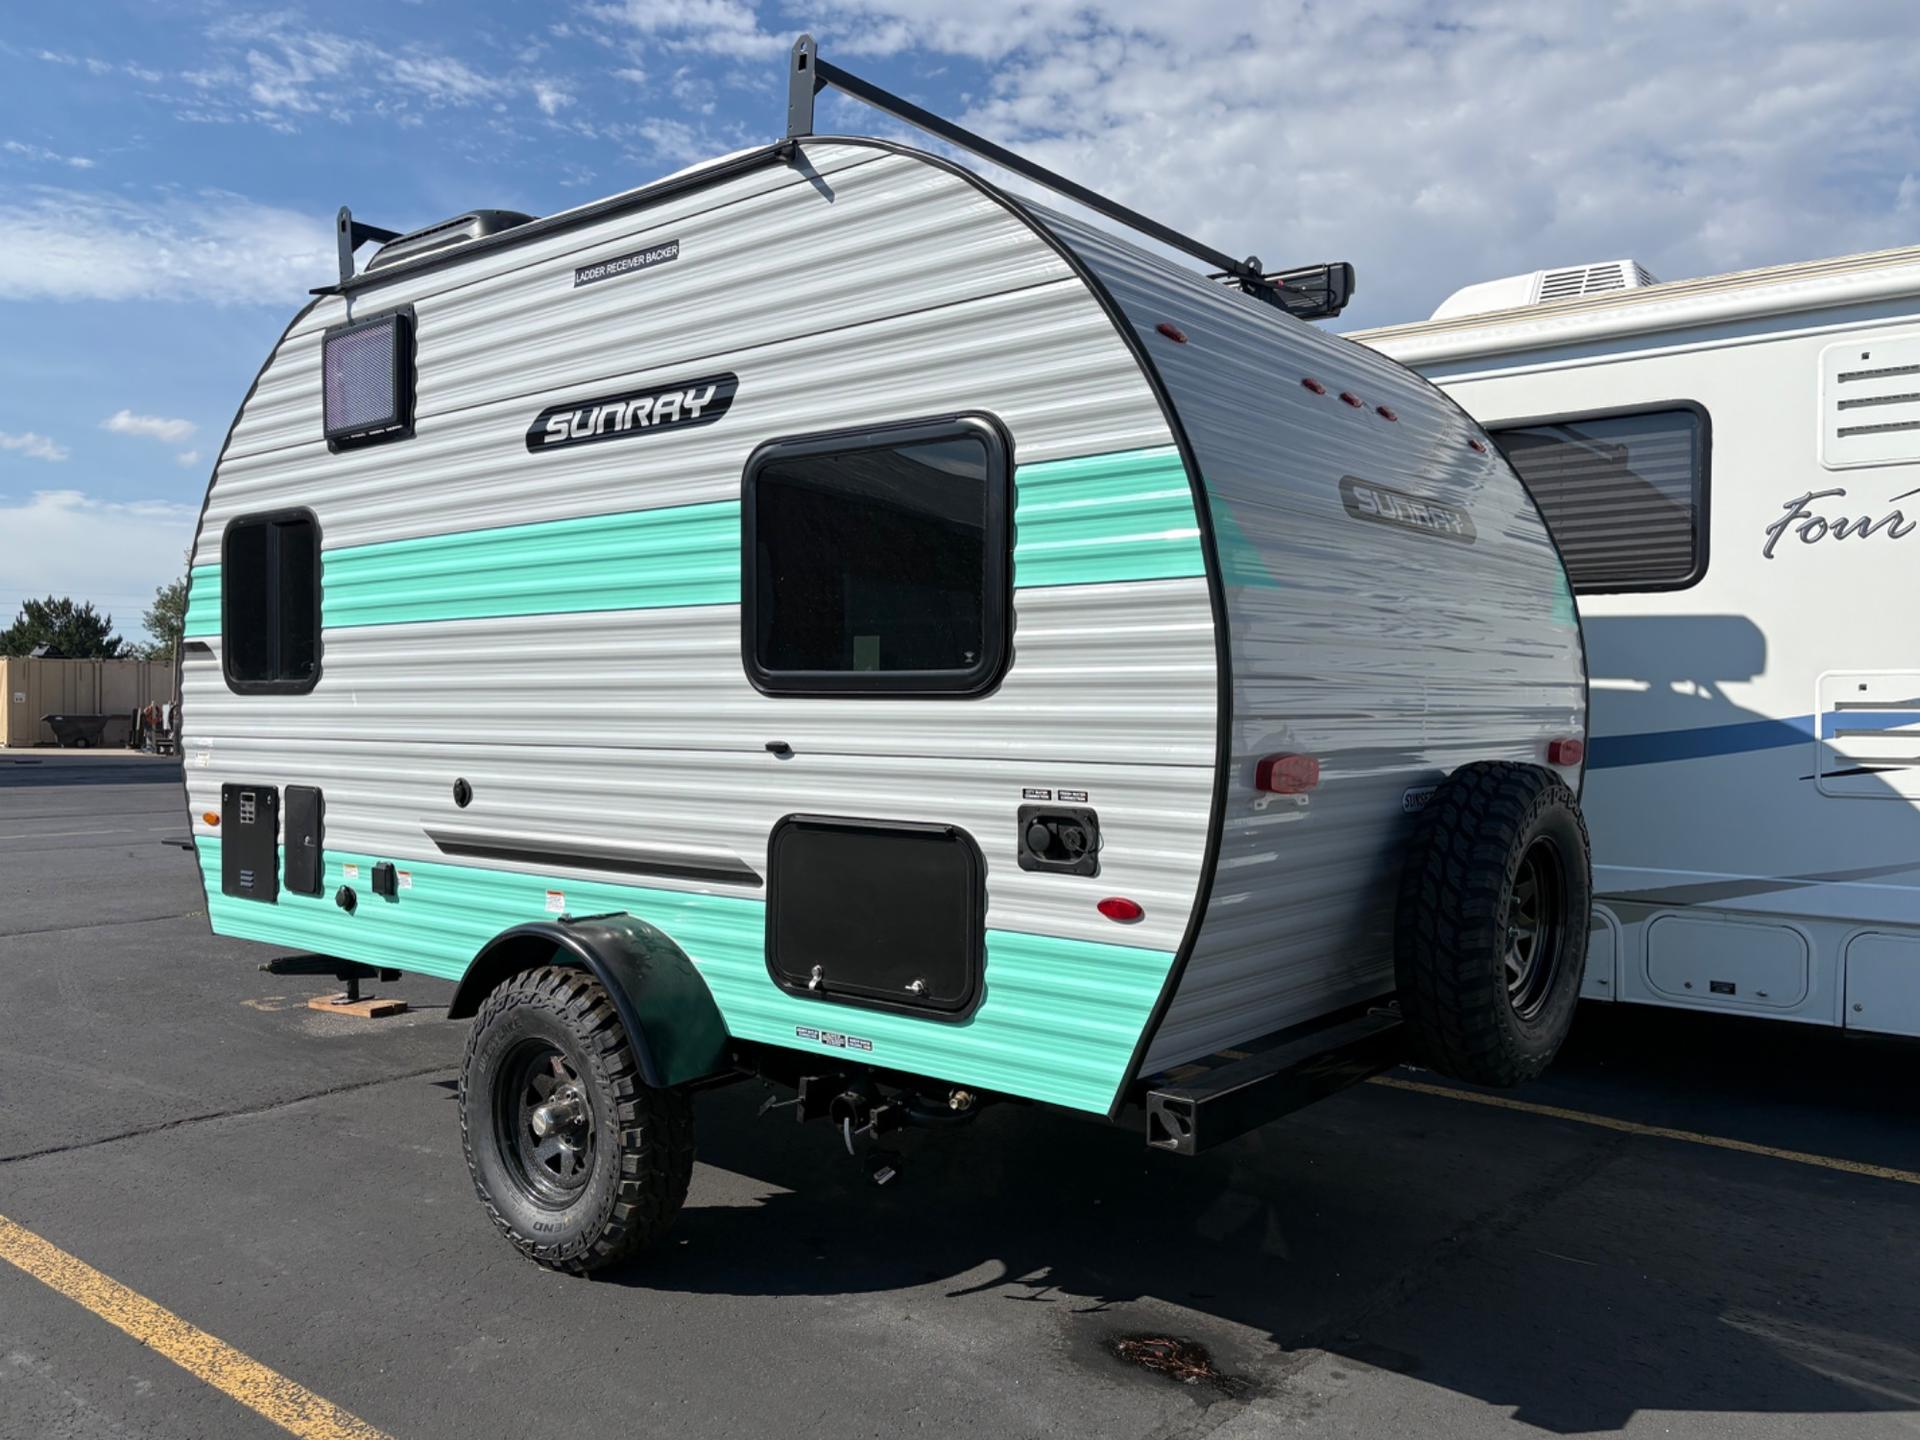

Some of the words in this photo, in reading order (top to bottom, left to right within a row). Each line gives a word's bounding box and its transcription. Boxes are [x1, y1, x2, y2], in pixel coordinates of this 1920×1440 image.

[576, 266, 606, 283] LADDER
[606, 256, 645, 274] RECEIVER
[645, 245, 678, 263] BACKER
[544, 386, 716, 443] SUNRAY
[1353, 486, 1464, 534] SUNRAY
